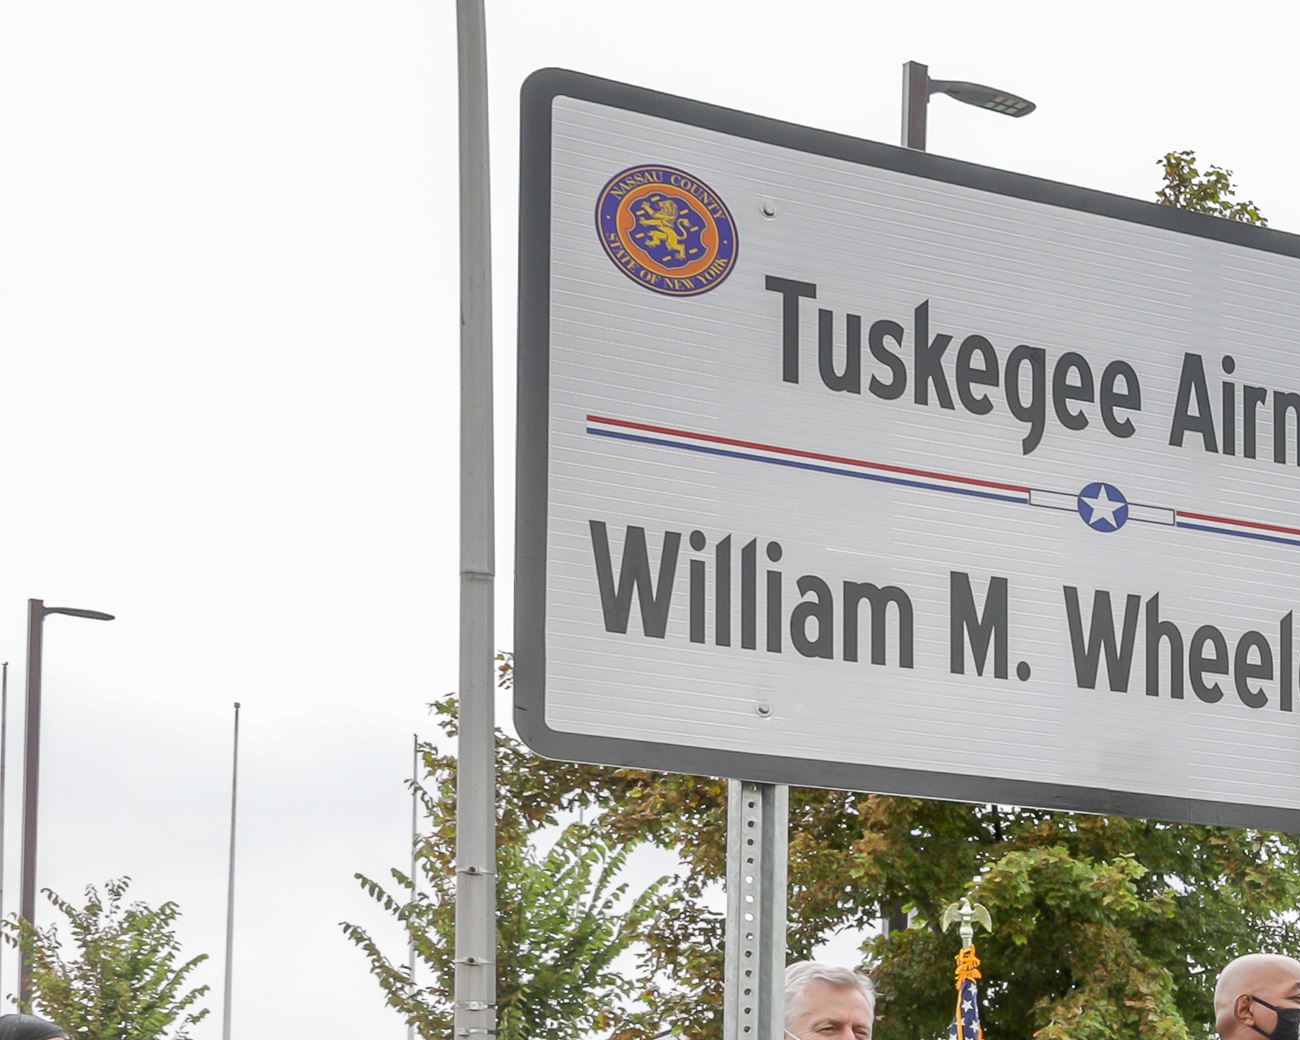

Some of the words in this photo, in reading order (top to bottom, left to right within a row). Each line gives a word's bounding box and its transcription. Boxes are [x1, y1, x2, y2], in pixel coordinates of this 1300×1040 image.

[610, 171, 664, 200] NASSAU
[670, 174, 726, 220] COUNTY
[607, 233, 639, 272] STATE
[640, 269, 658, 284] OF
[664, 278, 695, 290] NEW
[697, 258, 728, 285] YORK
[764, 274, 1141, 456] Tuskegee
[588, 519, 914, 669] William
[950, 570, 1031, 682] M.
